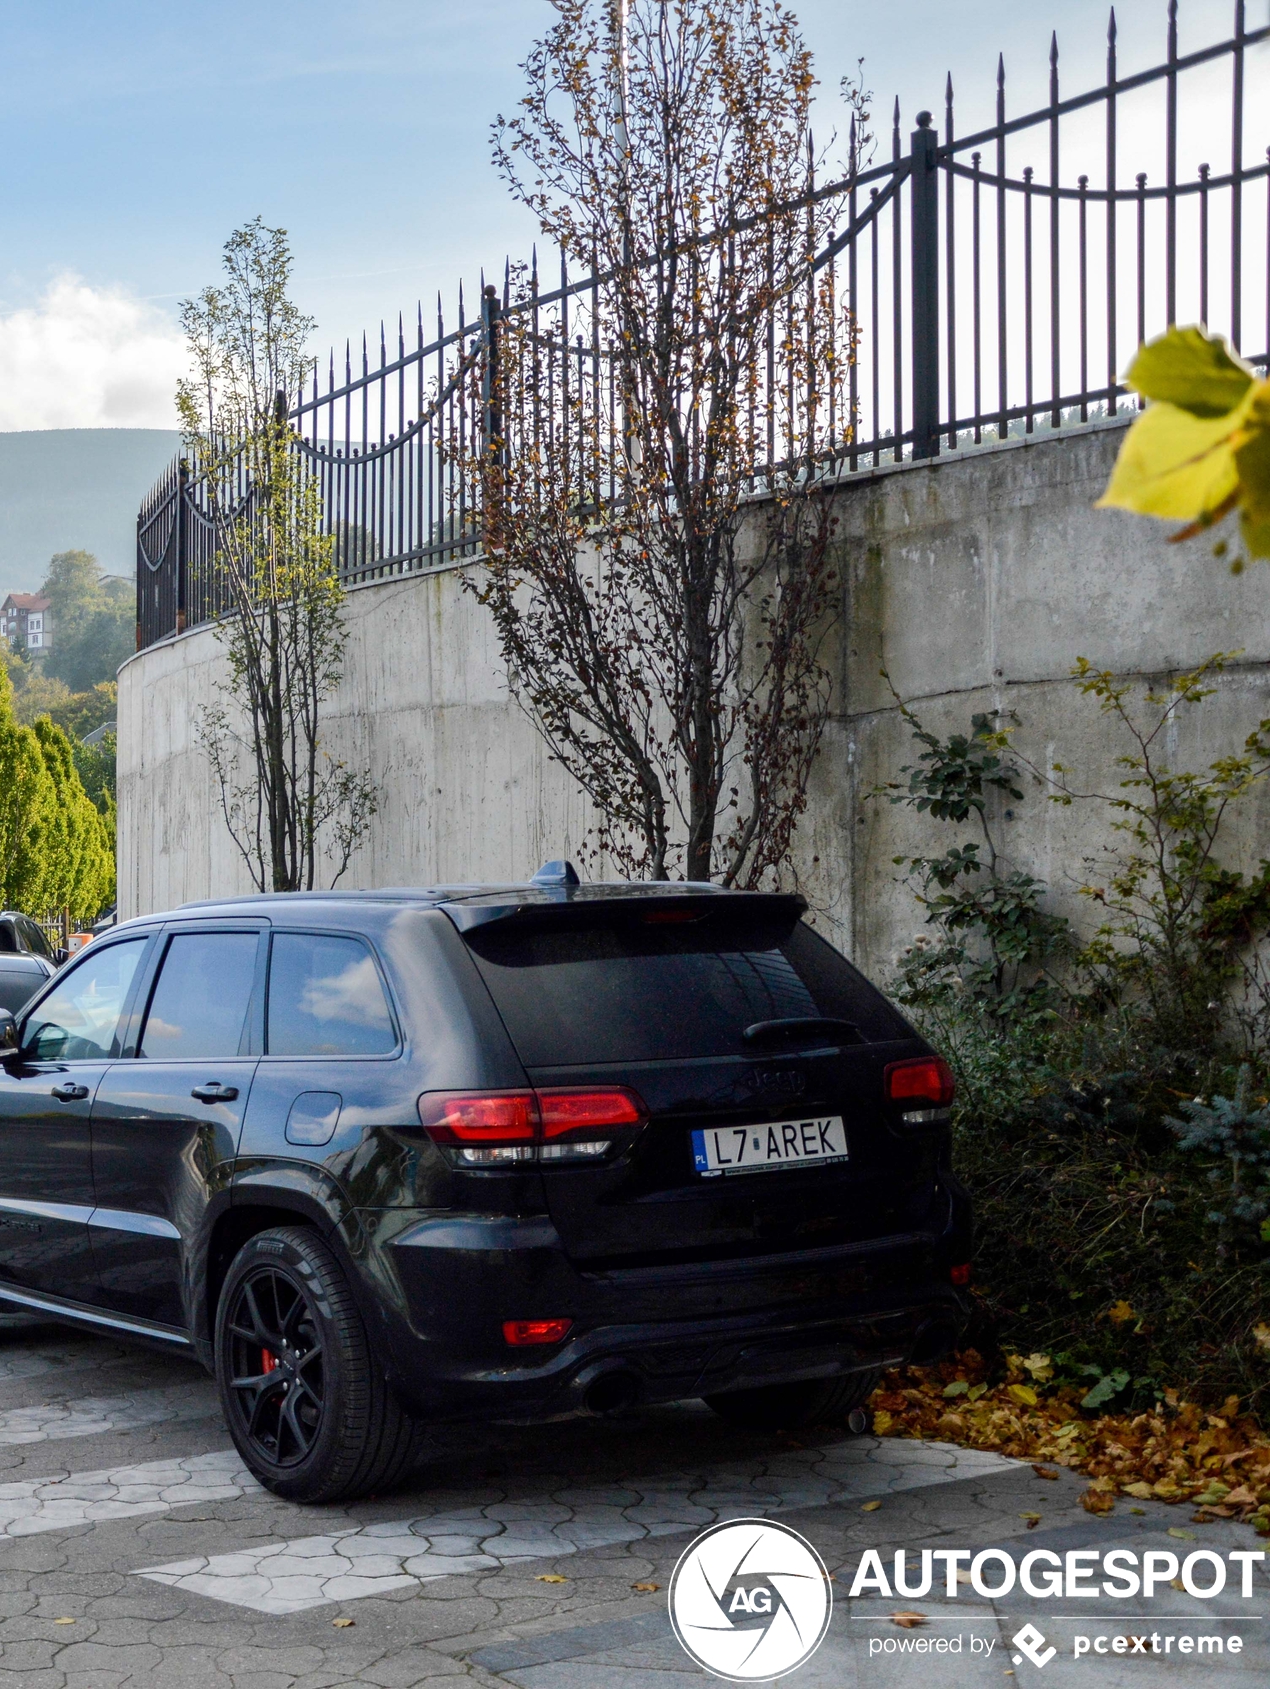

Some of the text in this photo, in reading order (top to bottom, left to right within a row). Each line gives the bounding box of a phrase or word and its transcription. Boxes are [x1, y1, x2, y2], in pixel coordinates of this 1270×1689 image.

[714, 1120, 836, 1165] L7 AREK
[695, 1155, 706, 1164] PL
